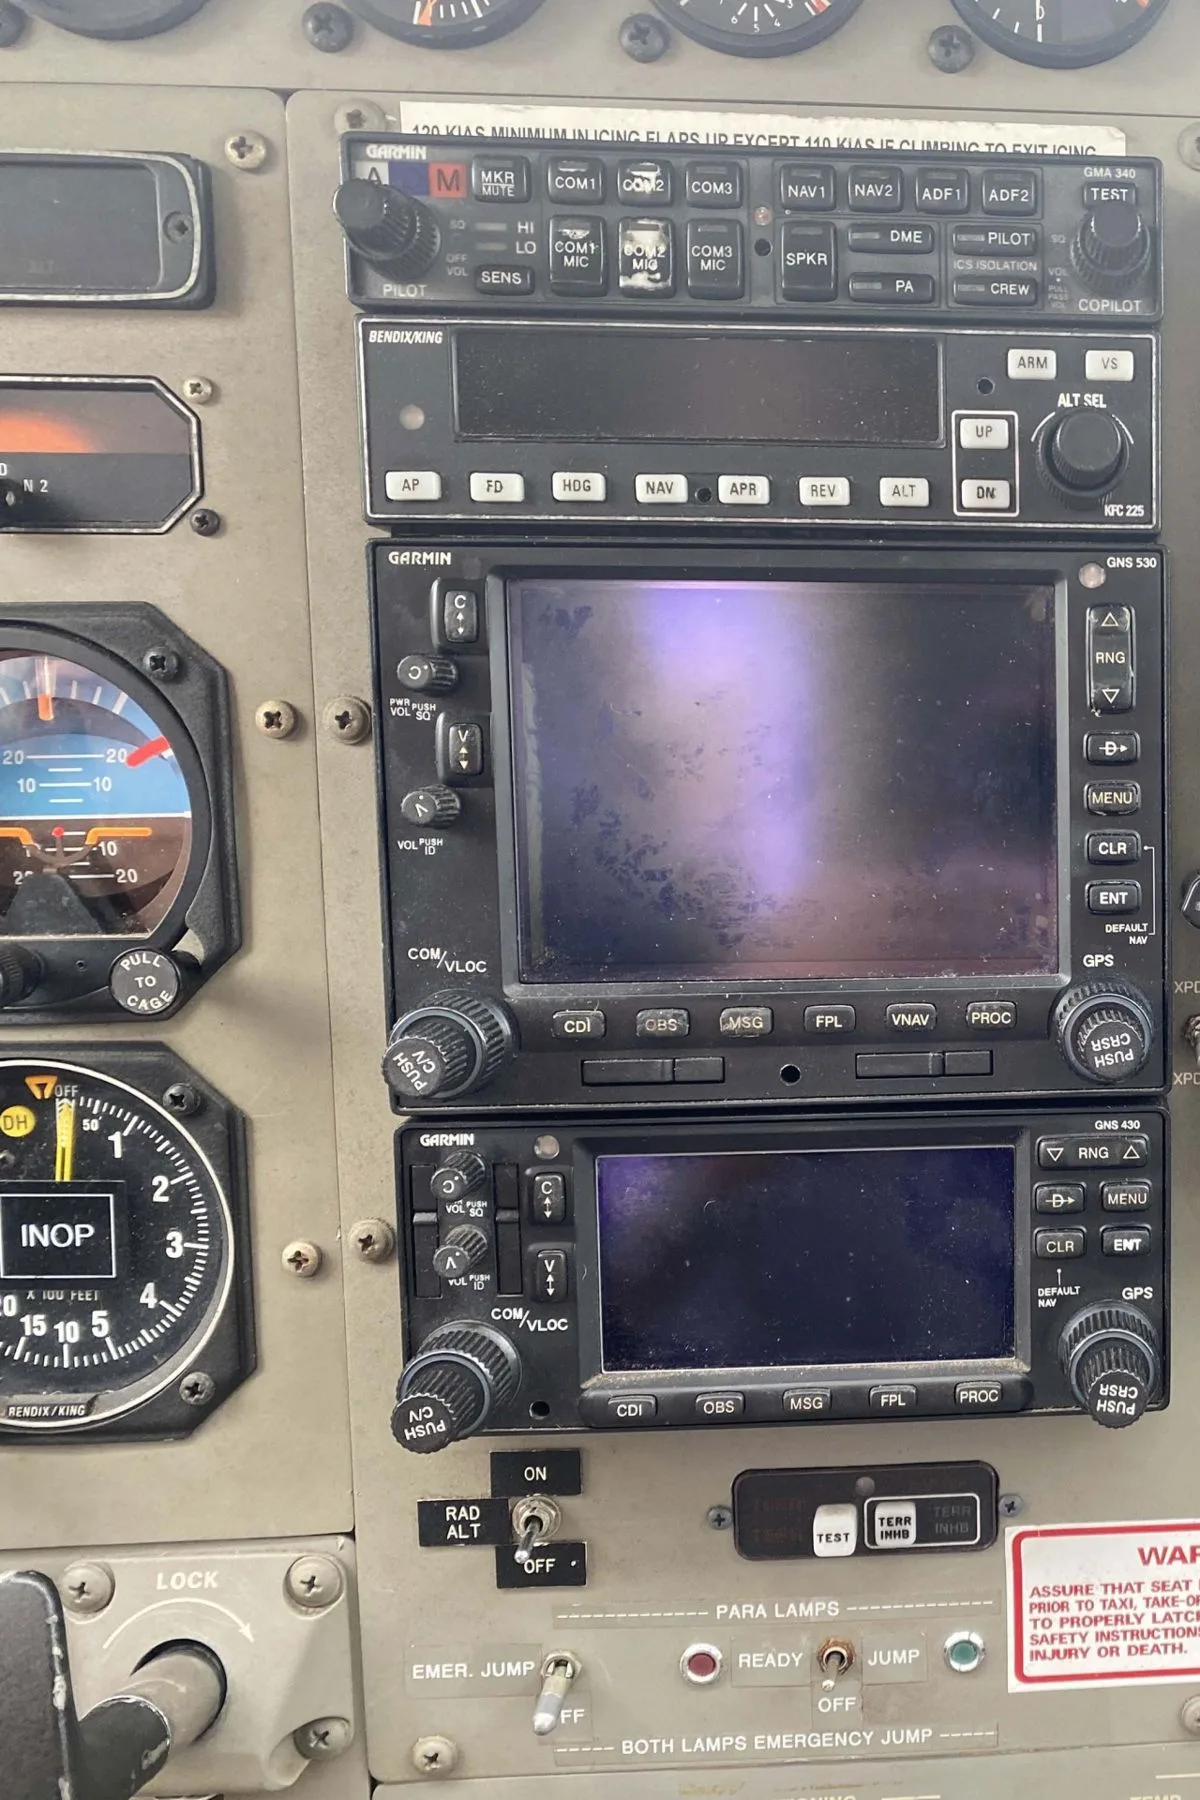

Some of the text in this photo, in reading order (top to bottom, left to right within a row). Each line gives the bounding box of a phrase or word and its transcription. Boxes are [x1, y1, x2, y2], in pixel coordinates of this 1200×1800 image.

[366, 145, 427, 159] GARMIN
[1084, 168, 1136, 180] GMA 340
[555, 176, 596, 190] COM1
[692, 182, 733, 195] COM3
[788, 185, 825, 199] NAV1
[854, 184, 893, 197] NAV2
[922, 187, 961, 200] ADF1
[989, 188, 1028, 202] ADF2
[1090, 188, 1128, 202] TEST
[890, 230, 923, 243] DME
[988, 232, 1031, 246] PILOT
[786, 252, 828, 267] SPKR
[481, 272, 522, 285] SENS
[383, 284, 427, 297] PILOT
[990, 283, 1030, 296] CREW
[1078, 299, 1141, 313] COPILOT
[369, 330, 443, 344] BENDIX/KING
[1017, 356, 1048, 369] ARM
[1057, 393, 1106, 408] ALT SEL
[975, 426, 993, 438] UP
[402, 479, 420, 491] AP
[486, 480, 503, 493] FD
[563, 479, 591, 492] HDG
[646, 481, 674, 494] NAV
[729, 482, 757, 495] APR
[811, 484, 836, 497] REV
[891, 484, 916, 497] ALT
[389, 552, 451, 565] GARMIN
[1107, 557, 1157, 568] GNS 530
[1096, 652, 1125, 664] RNG
[1092, 792, 1132, 804] MENU
[1099, 843, 1127, 855] CLR
[1100, 892, 1128, 905] ENT
[1105, 923, 1148, 933] DEFAULT
[1129, 936, 1148, 945] NAV
[408, 948, 487, 973] COM/VLOC
[1083, 955, 1114, 967] GPS
[816, 1014, 842, 1028] FPL
[892, 1012, 929, 1026] VNAV
[971, 1011, 1011, 1025] PROC
[1095, 1120, 1140, 1130] GNS 430
[21, 1223, 95, 1248] INOP
[1122, 1287, 1153, 1299] GPS
[491, 1308, 568, 1331] COM/VLOC
[790, 1396, 823, 1410] MSG
[880, 1394, 906, 1407] FPL
[960, 1390, 999, 1403] PROC
[703, 1400, 734, 1414] OBS
[524, 1467, 546, 1481] ON
[446, 1506, 480, 1521] RAD
[879, 1516, 911, 1526] TERR
[447, 1524, 480, 1539] ALT
[816, 1532, 850, 1543] TEST
[880, 1530, 909, 1540] INHB
[524, 1559, 556, 1573] OFF
[156, 1571, 218, 1590] LOCK
[1030, 1583, 1094, 1598] ASSURE
[1100, 1581, 1145, 1595] THAT
[1151, 1579, 1192, 1593] SEAT
[716, 1602, 839, 1620] PARA LAMPS
[1029, 1631, 1089, 1646] SAFETY
[738, 1652, 803, 1668] READY
[868, 1649, 920, 1666] JUMP
[412, 1661, 535, 1680] EMER. JUMP
[818, 1697, 856, 1713] OFF
[622, 1729, 933, 1754] BOTH LAMPS EMERGENCY JUMP
